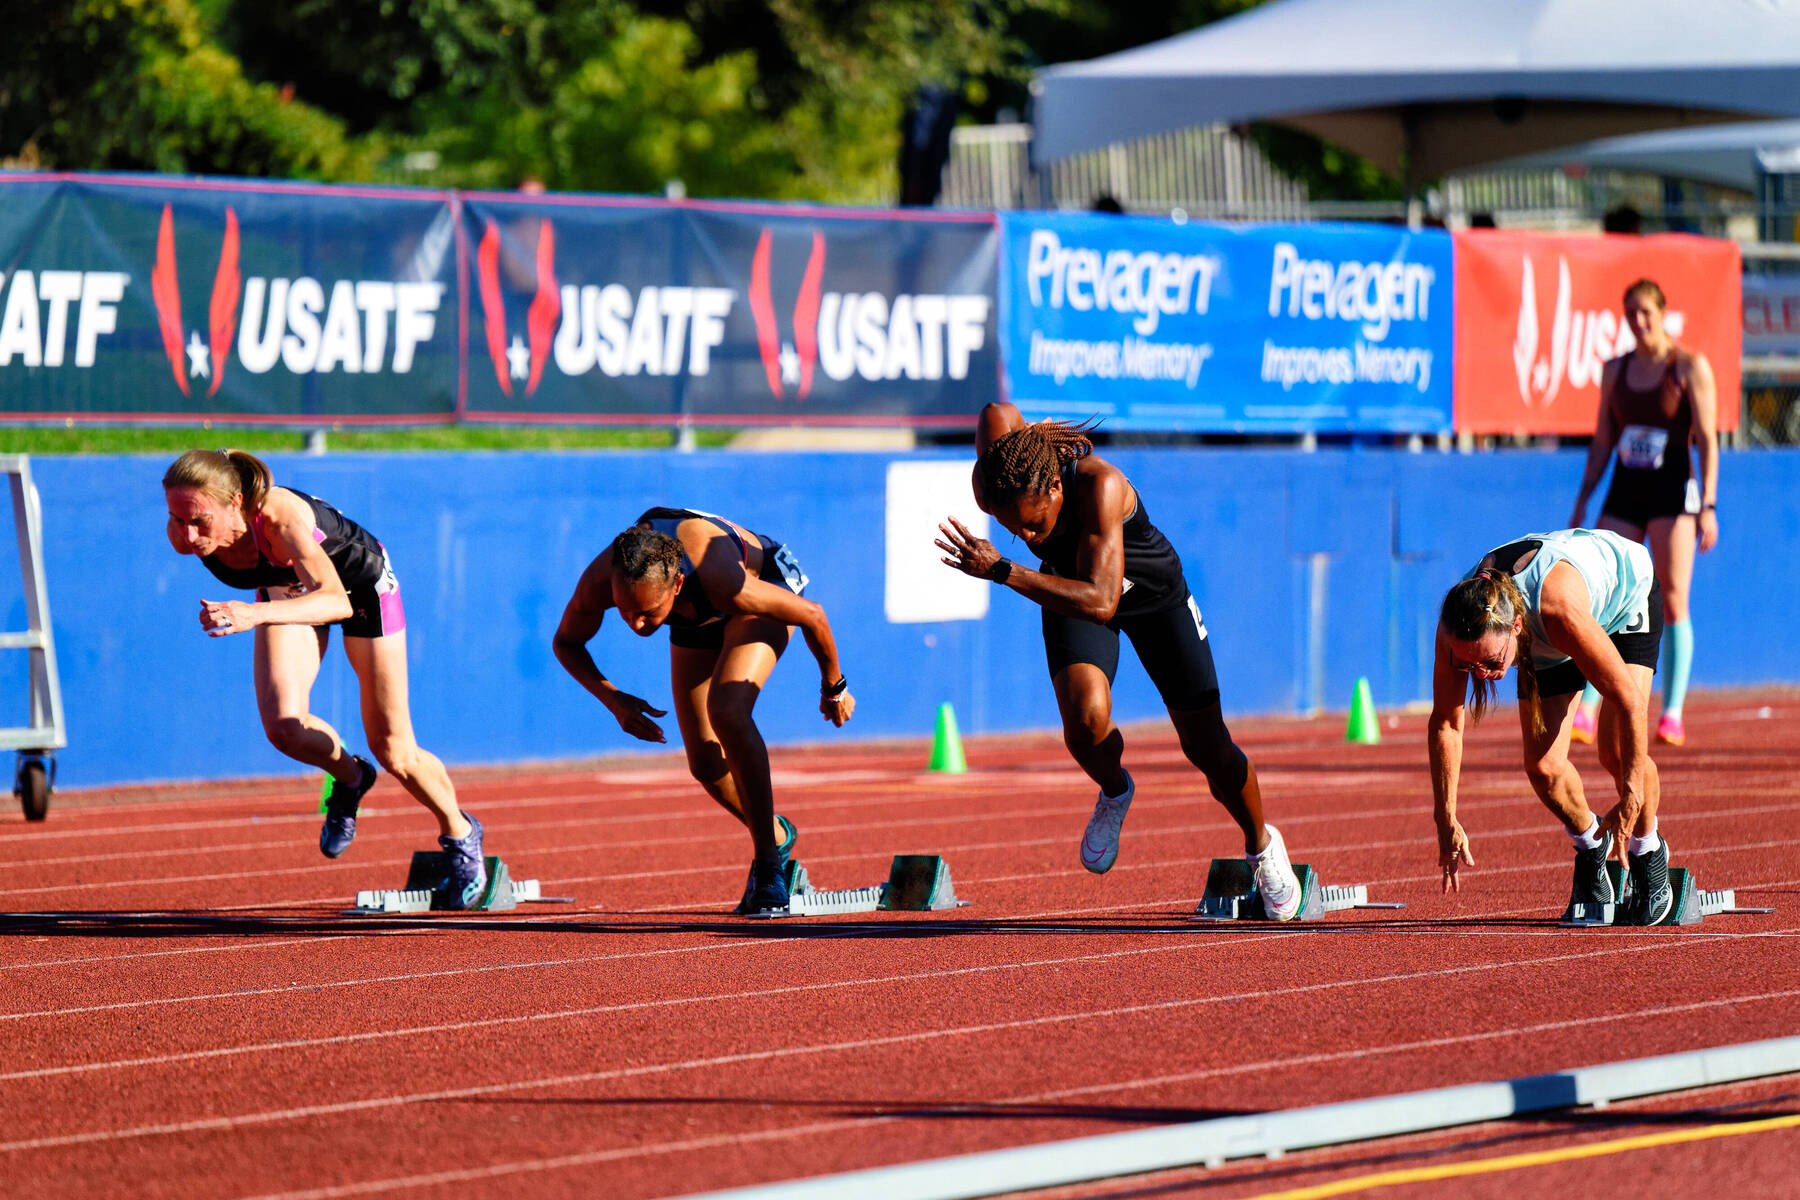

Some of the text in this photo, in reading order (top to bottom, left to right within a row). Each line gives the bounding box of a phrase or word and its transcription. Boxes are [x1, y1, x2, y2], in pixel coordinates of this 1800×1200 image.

[0, 270, 130, 367] ATF
[238, 276, 443, 375] USATF
[1027, 229, 1217, 336] Prevagen
[1268, 242, 1434, 342] Prevagen
[552, 284, 737, 377] USATF
[817, 291, 990, 381] USATF
[1028, 329, 1122, 386] Improves
[1261, 337, 1354, 392] Improves
[777, 551, 803, 586] 5
